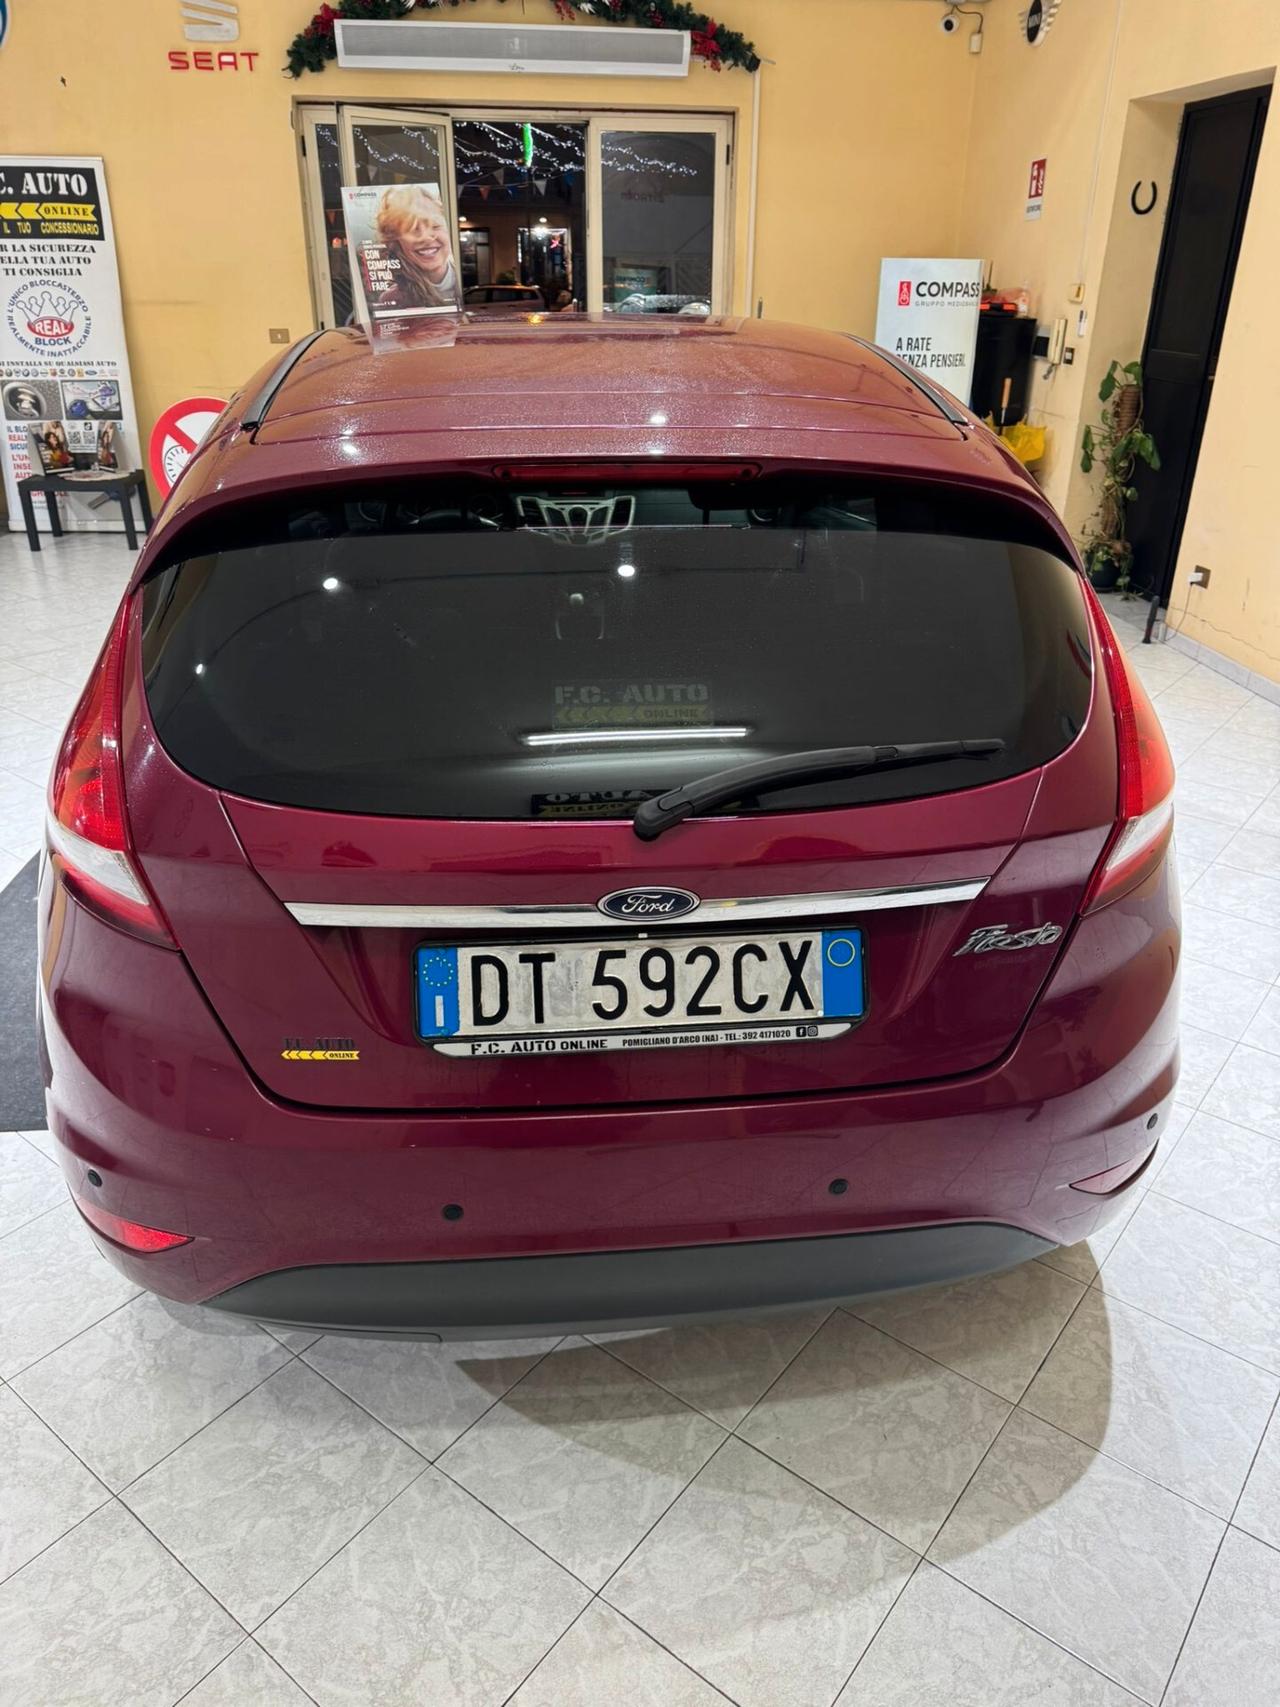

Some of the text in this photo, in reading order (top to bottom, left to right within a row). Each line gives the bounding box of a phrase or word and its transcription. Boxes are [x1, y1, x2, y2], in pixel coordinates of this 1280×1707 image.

[168, 51, 259, 71] SEAT
[21, 172, 88, 197] AUTO
[43, 206, 90, 216] ONLINE
[17, 222, 32, 234] TUO
[40, 222, 100, 236] CONCESSIONARIO
[12, 244, 27, 253] LA
[29, 244, 96, 254] SICUREZZA
[364, 249, 380, 260] CON
[31, 256, 56, 265] TUA
[59, 256, 92, 265] AUTO
[366, 259, 401, 270] COMPASS
[4, 268, 83, 277] TI CONSIGLIA
[369, 271, 378, 281] SI
[371, 281, 391, 292] FARE
[916, 281, 980, 297] COMPASS
[29, 279, 89, 313] BLOCCASTERZO
[34, 320, 69, 336] REAL
[34, 337, 72, 346] BLOCK
[47, 316, 92, 357] INATTACCABILE
[896, 337, 932, 351] A RATE
[896, 354, 927, 367] ENZA
[554, 683, 709, 704] F.C. AUTO
[621, 894, 676, 913] Ford
[952, 921, 1063, 957] Fiesta
[471, 939, 815, 1027] DT 592CX
[622, 1036, 670, 1047] POMIGLIANO
[672, 1035, 701, 1044] D'ARCO
[742, 1031, 758, 1041] 392
[759, 1029, 792, 1040] 4171020
[471, 1038, 608, 1055] F.C. AUTO ONLINE
